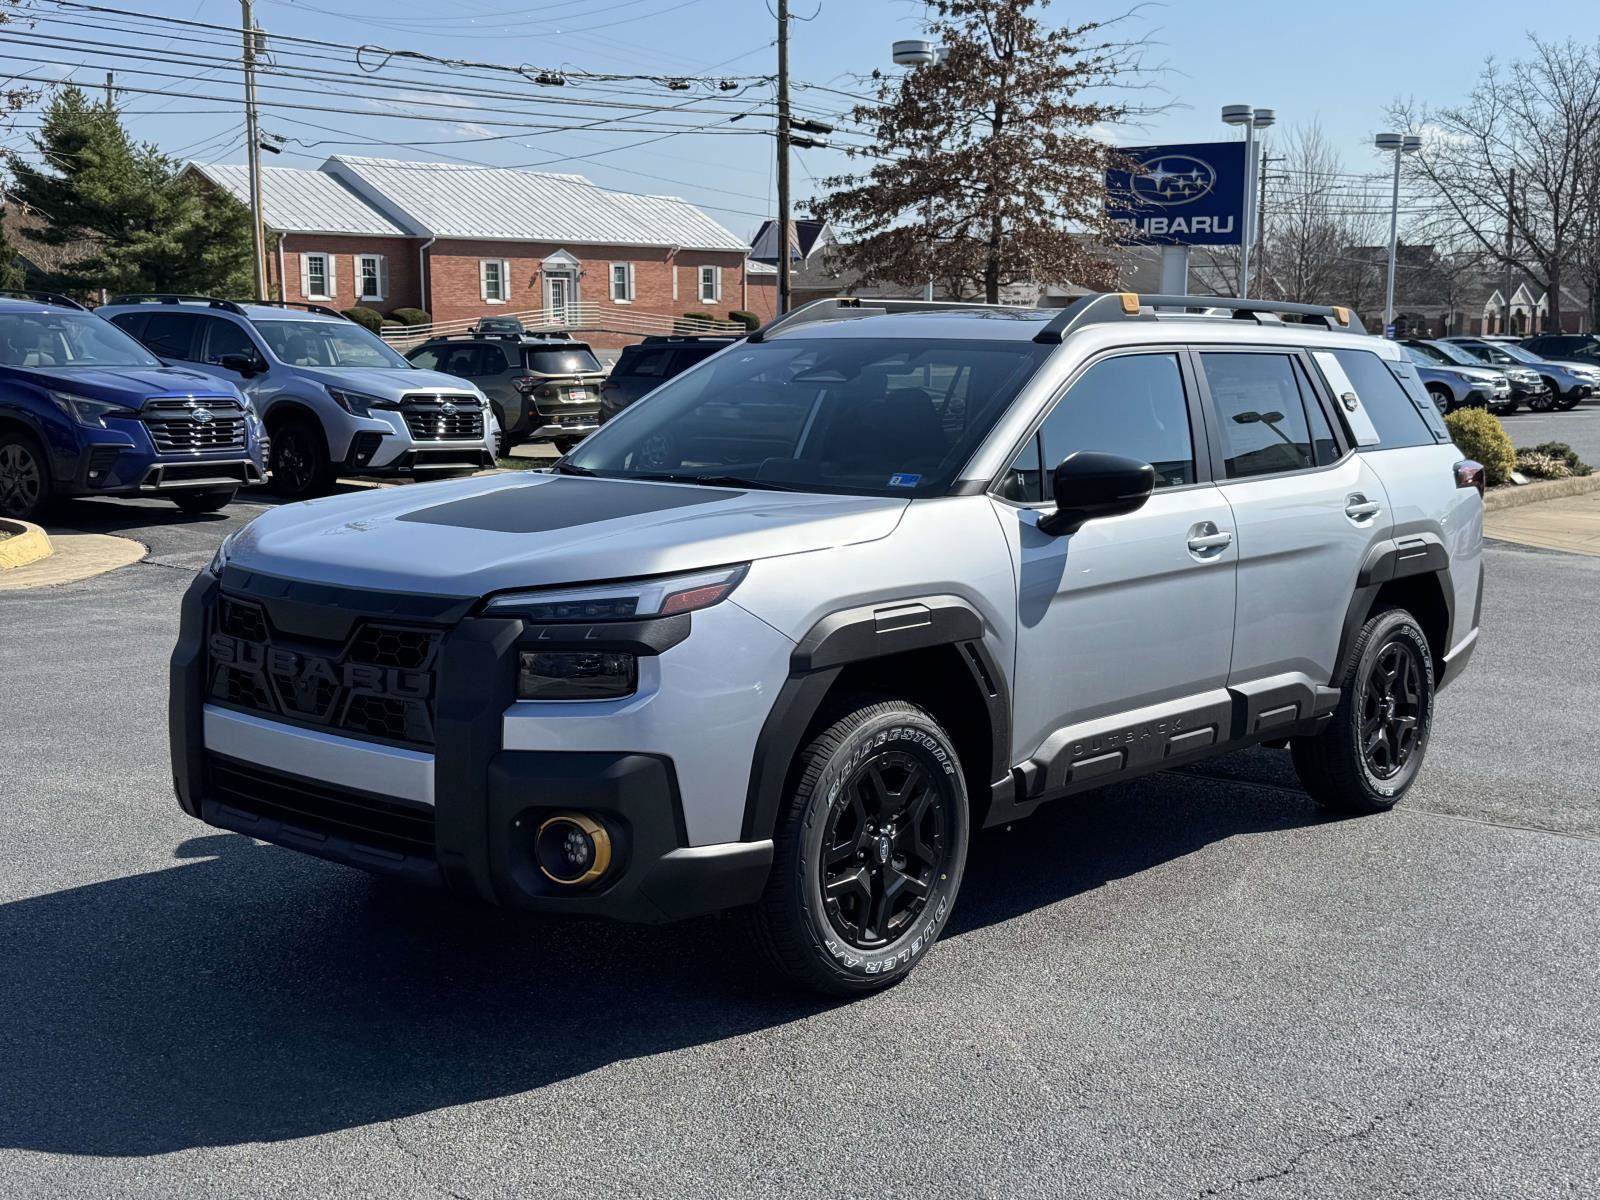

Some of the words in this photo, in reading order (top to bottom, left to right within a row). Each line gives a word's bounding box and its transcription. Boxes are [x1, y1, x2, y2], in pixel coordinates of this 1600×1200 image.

[209, 631, 432, 698] SUBARU
[827, 727, 955, 808] BRIDGESTONE
[1072, 718, 1184, 757] OUTBACK
[864, 896, 947, 974] DUELER
